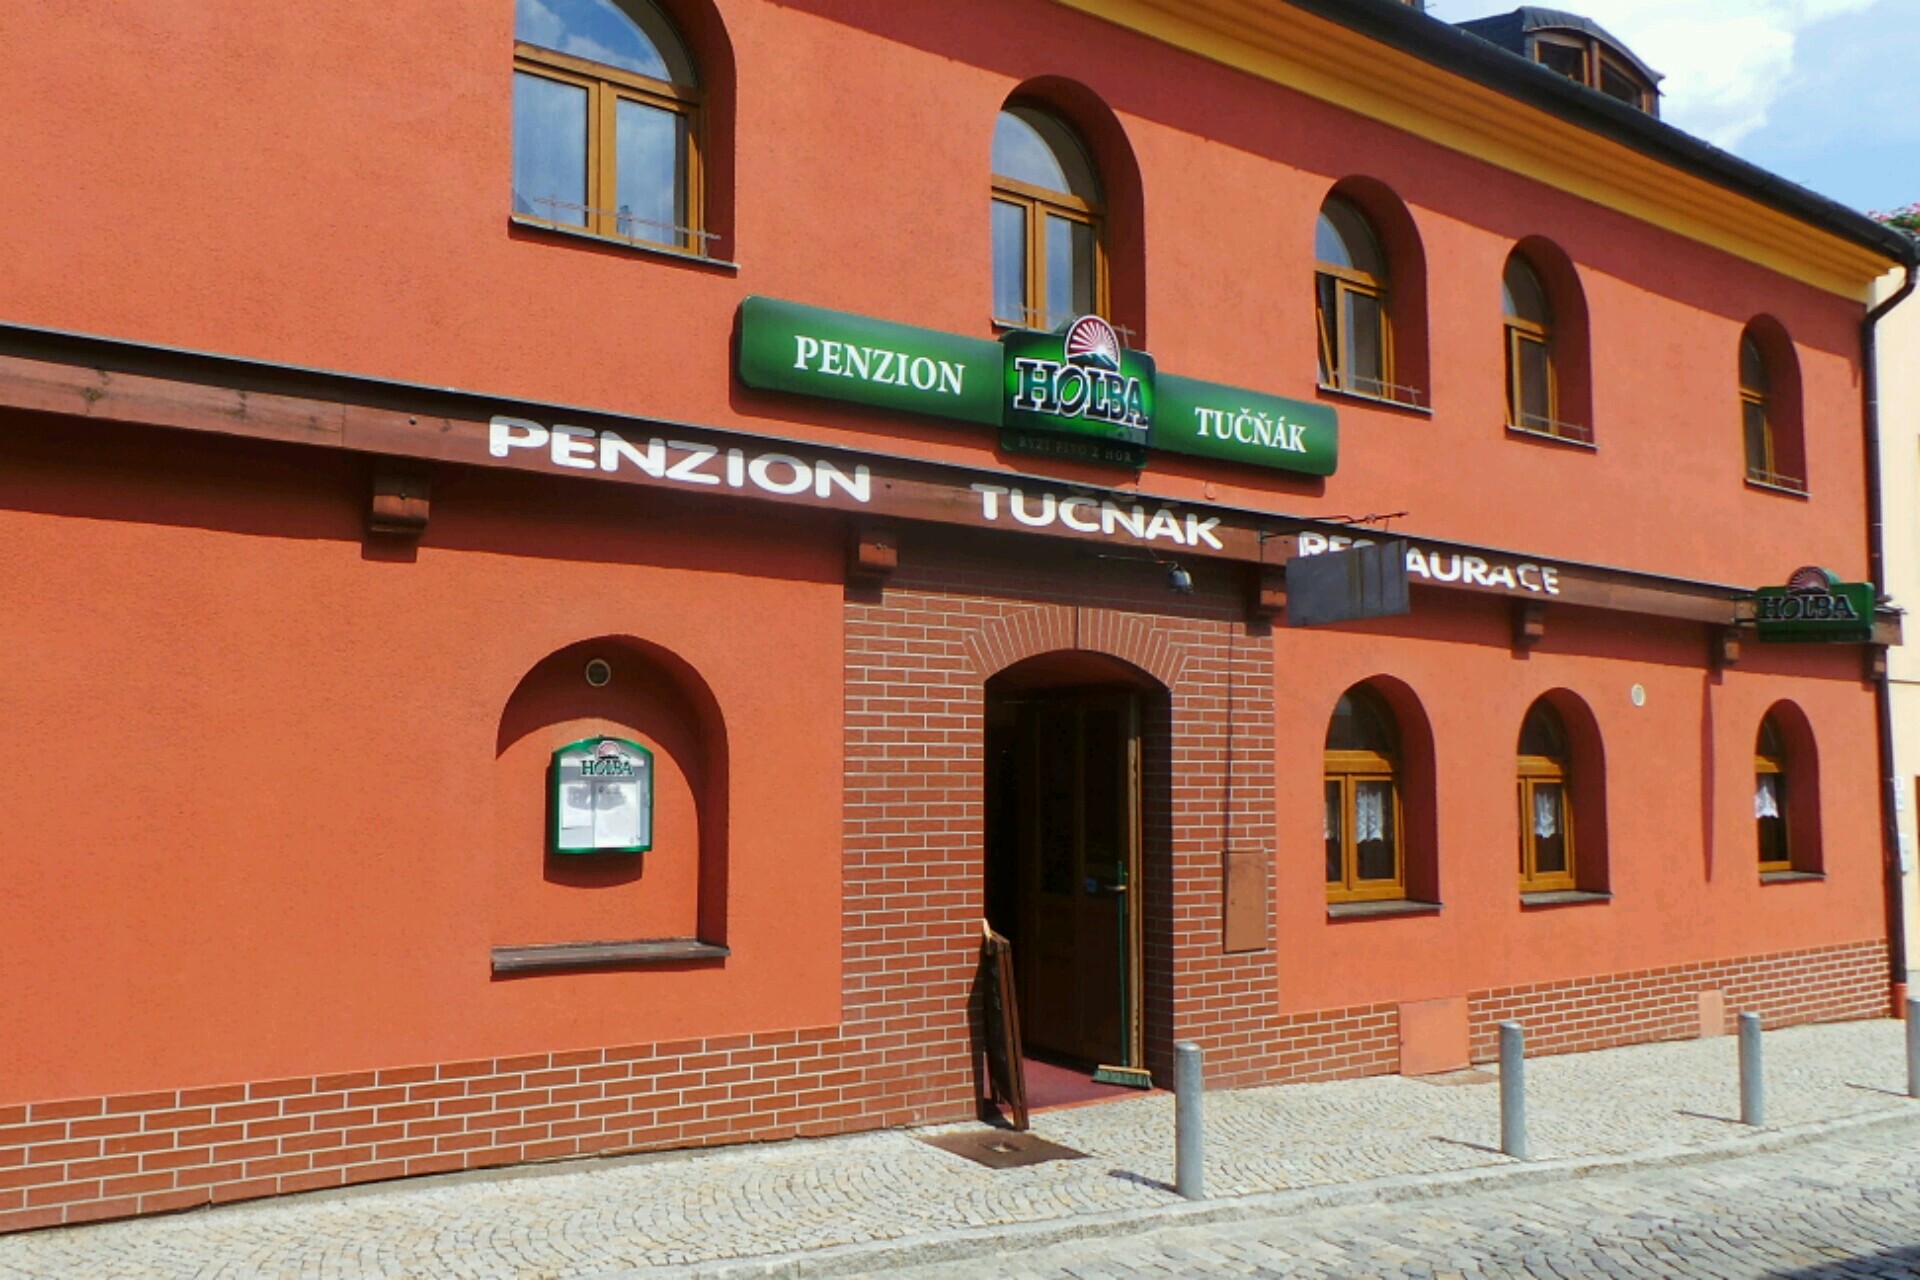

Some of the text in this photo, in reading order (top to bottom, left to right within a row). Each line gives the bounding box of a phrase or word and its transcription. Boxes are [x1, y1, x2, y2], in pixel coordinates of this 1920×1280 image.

[793, 334, 966, 396] PENZION
[1013, 357, 1148, 430] HOLBA
[1194, 406, 1307, 453] TUČŇÁK
[488, 414, 871, 503] PENZION
[1298, 531, 1560, 595] RAURACE
[1757, 594, 1859, 623] HOLBA
[580, 759, 634, 777] HOLBA
